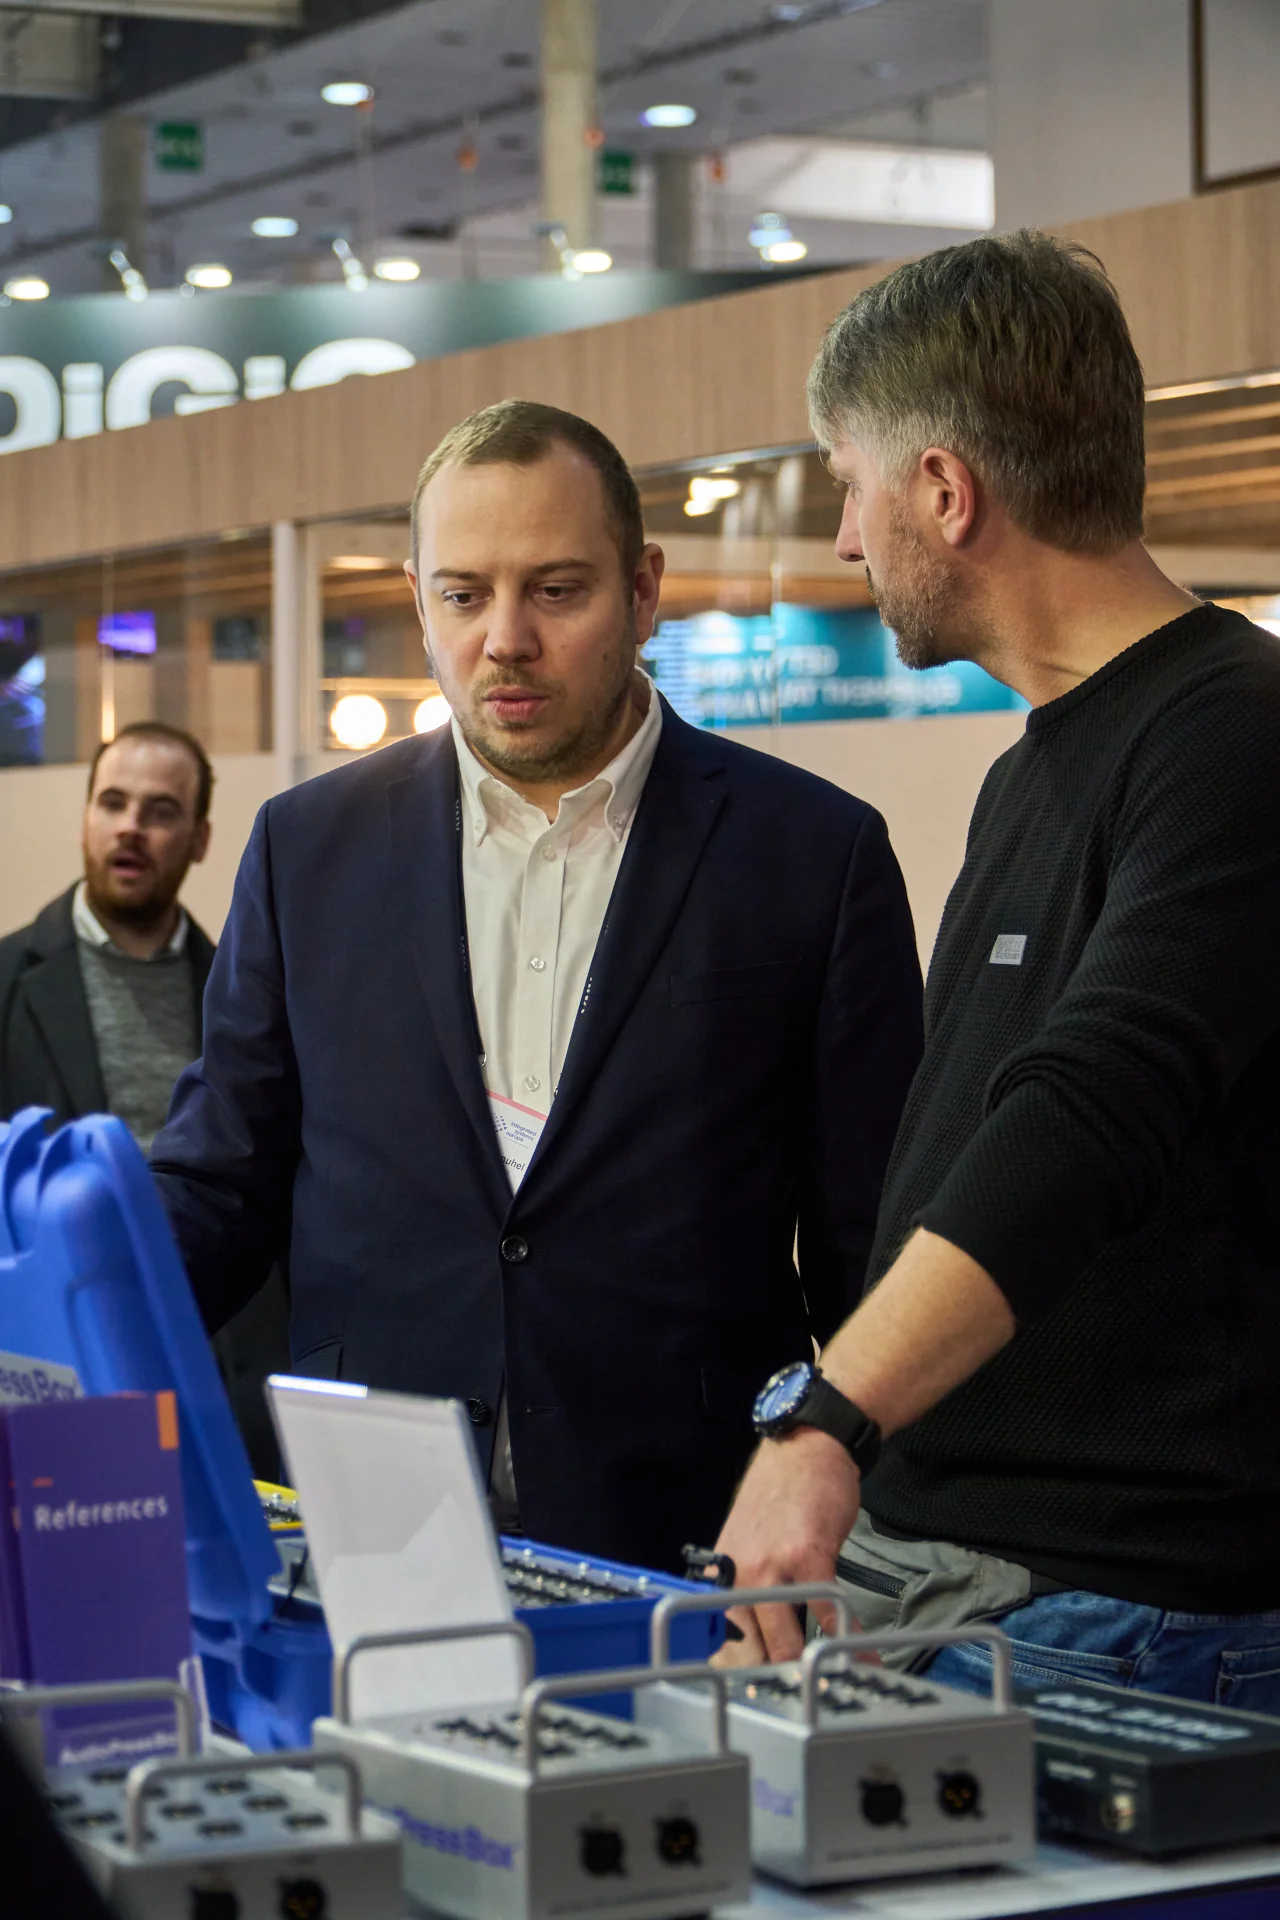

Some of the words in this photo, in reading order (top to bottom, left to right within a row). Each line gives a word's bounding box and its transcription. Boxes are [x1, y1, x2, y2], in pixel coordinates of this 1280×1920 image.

[505, 1131, 525, 1143] europe
[511, 1121, 537, 1137] integrated
[34, 1495, 168, 1531] References
